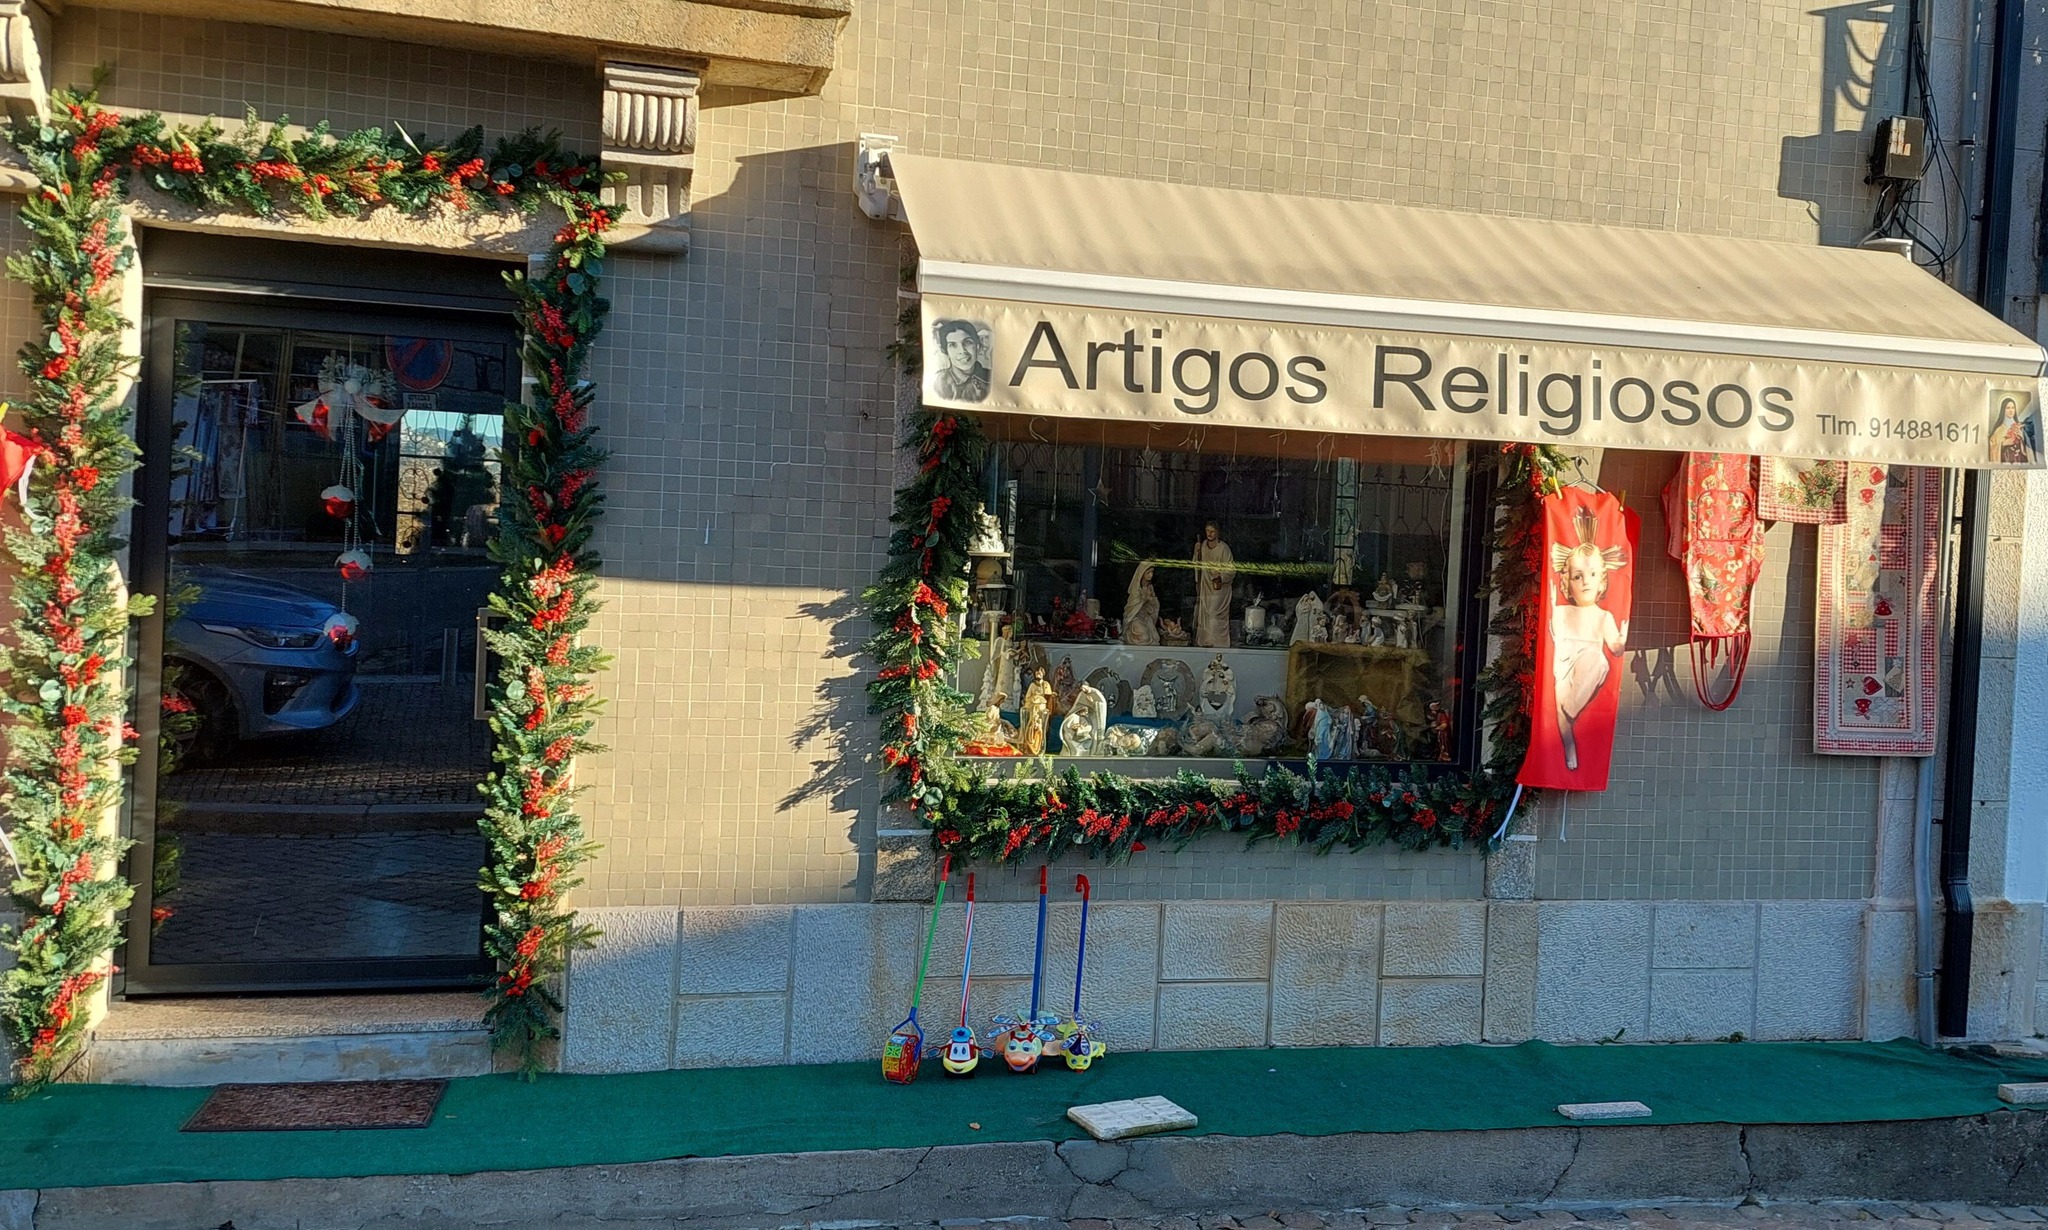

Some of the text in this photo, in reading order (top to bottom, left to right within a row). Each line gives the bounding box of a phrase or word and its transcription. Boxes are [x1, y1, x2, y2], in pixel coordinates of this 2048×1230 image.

[1008, 320, 1795, 436] Artigos Religiosos
[1816, 413, 1980, 445] Tlm. 914881611
